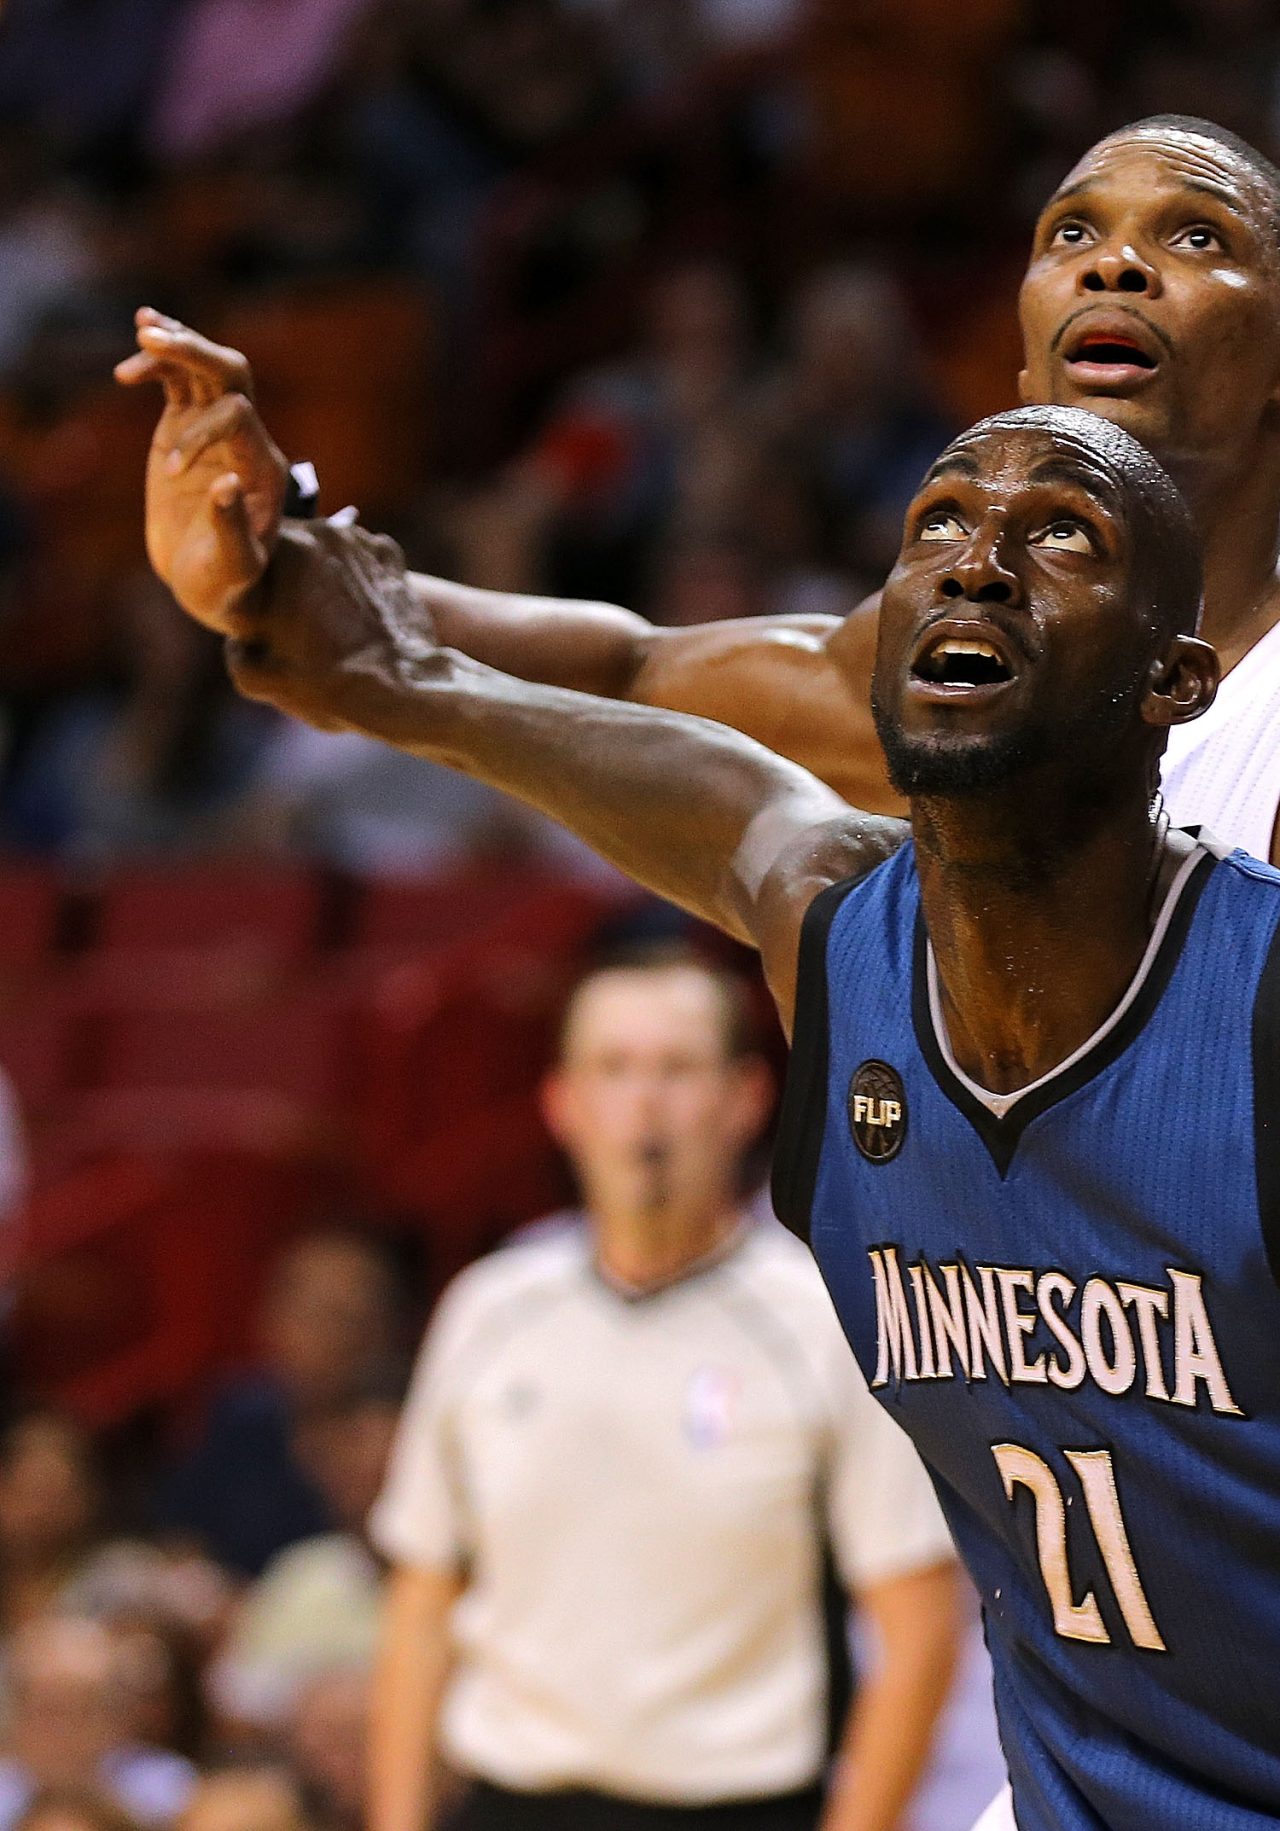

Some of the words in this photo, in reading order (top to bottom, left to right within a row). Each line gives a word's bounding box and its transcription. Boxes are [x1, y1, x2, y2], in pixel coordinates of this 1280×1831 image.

[853, 1095, 901, 1128] FLIP
[868, 1246, 1245, 1415] MINNESOTA
[991, 1443, 1166, 1651] 21
